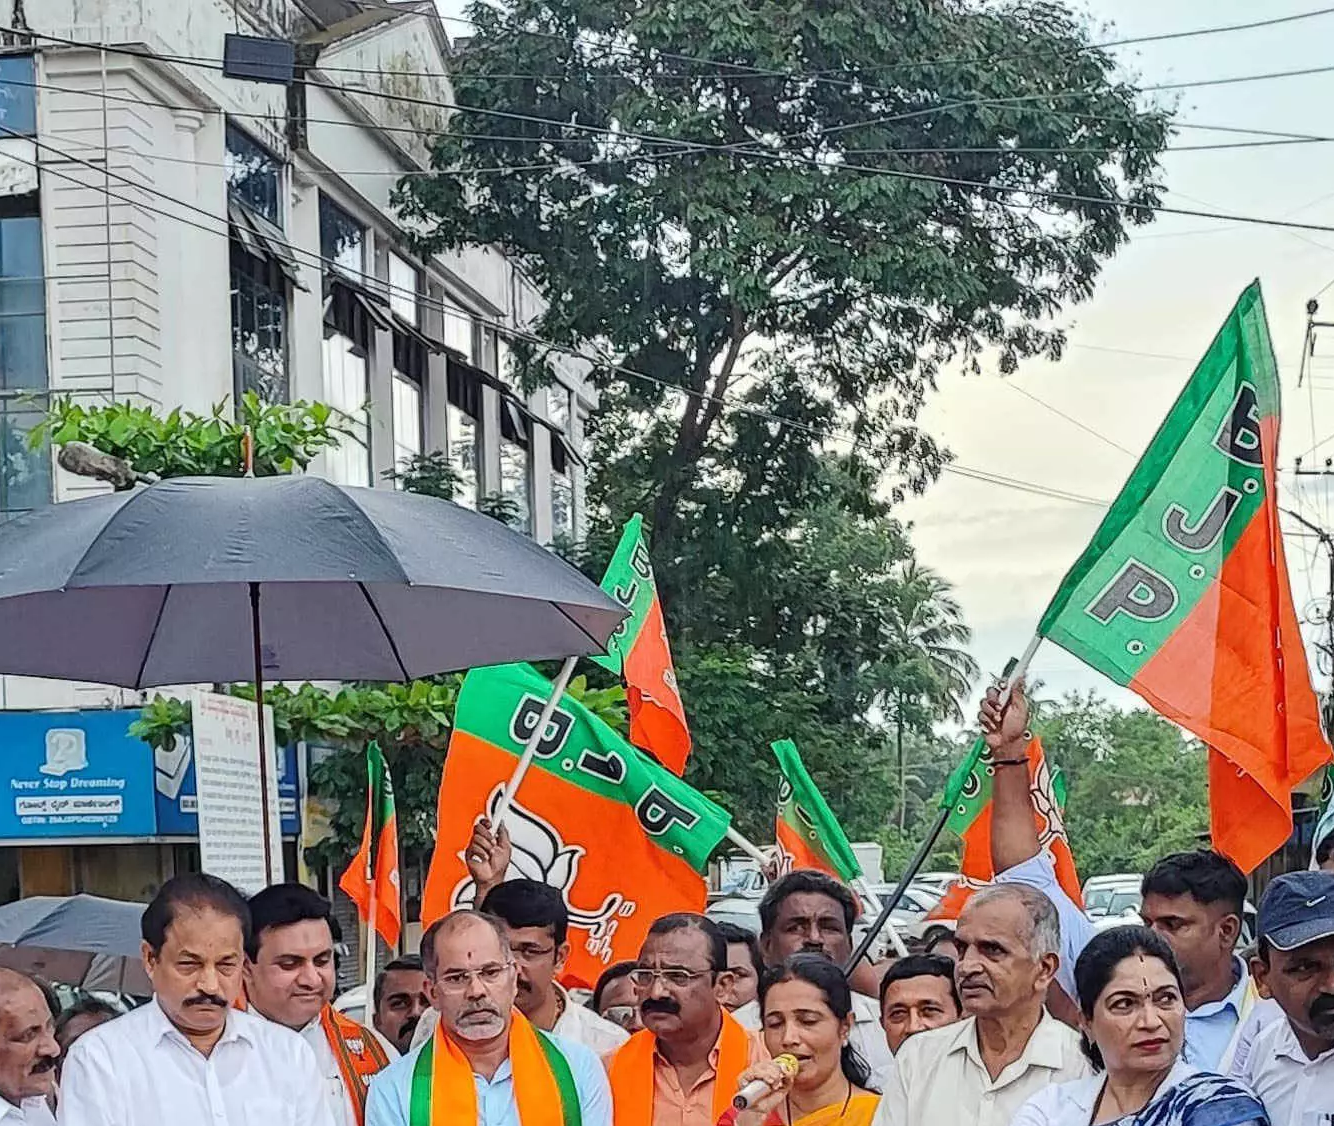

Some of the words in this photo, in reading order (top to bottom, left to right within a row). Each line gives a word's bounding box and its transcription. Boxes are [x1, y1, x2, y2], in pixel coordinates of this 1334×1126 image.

[10, 779, 41, 789] Never
[43, 778, 68, 790] Stop
[70, 777, 126, 789] Dreaming
